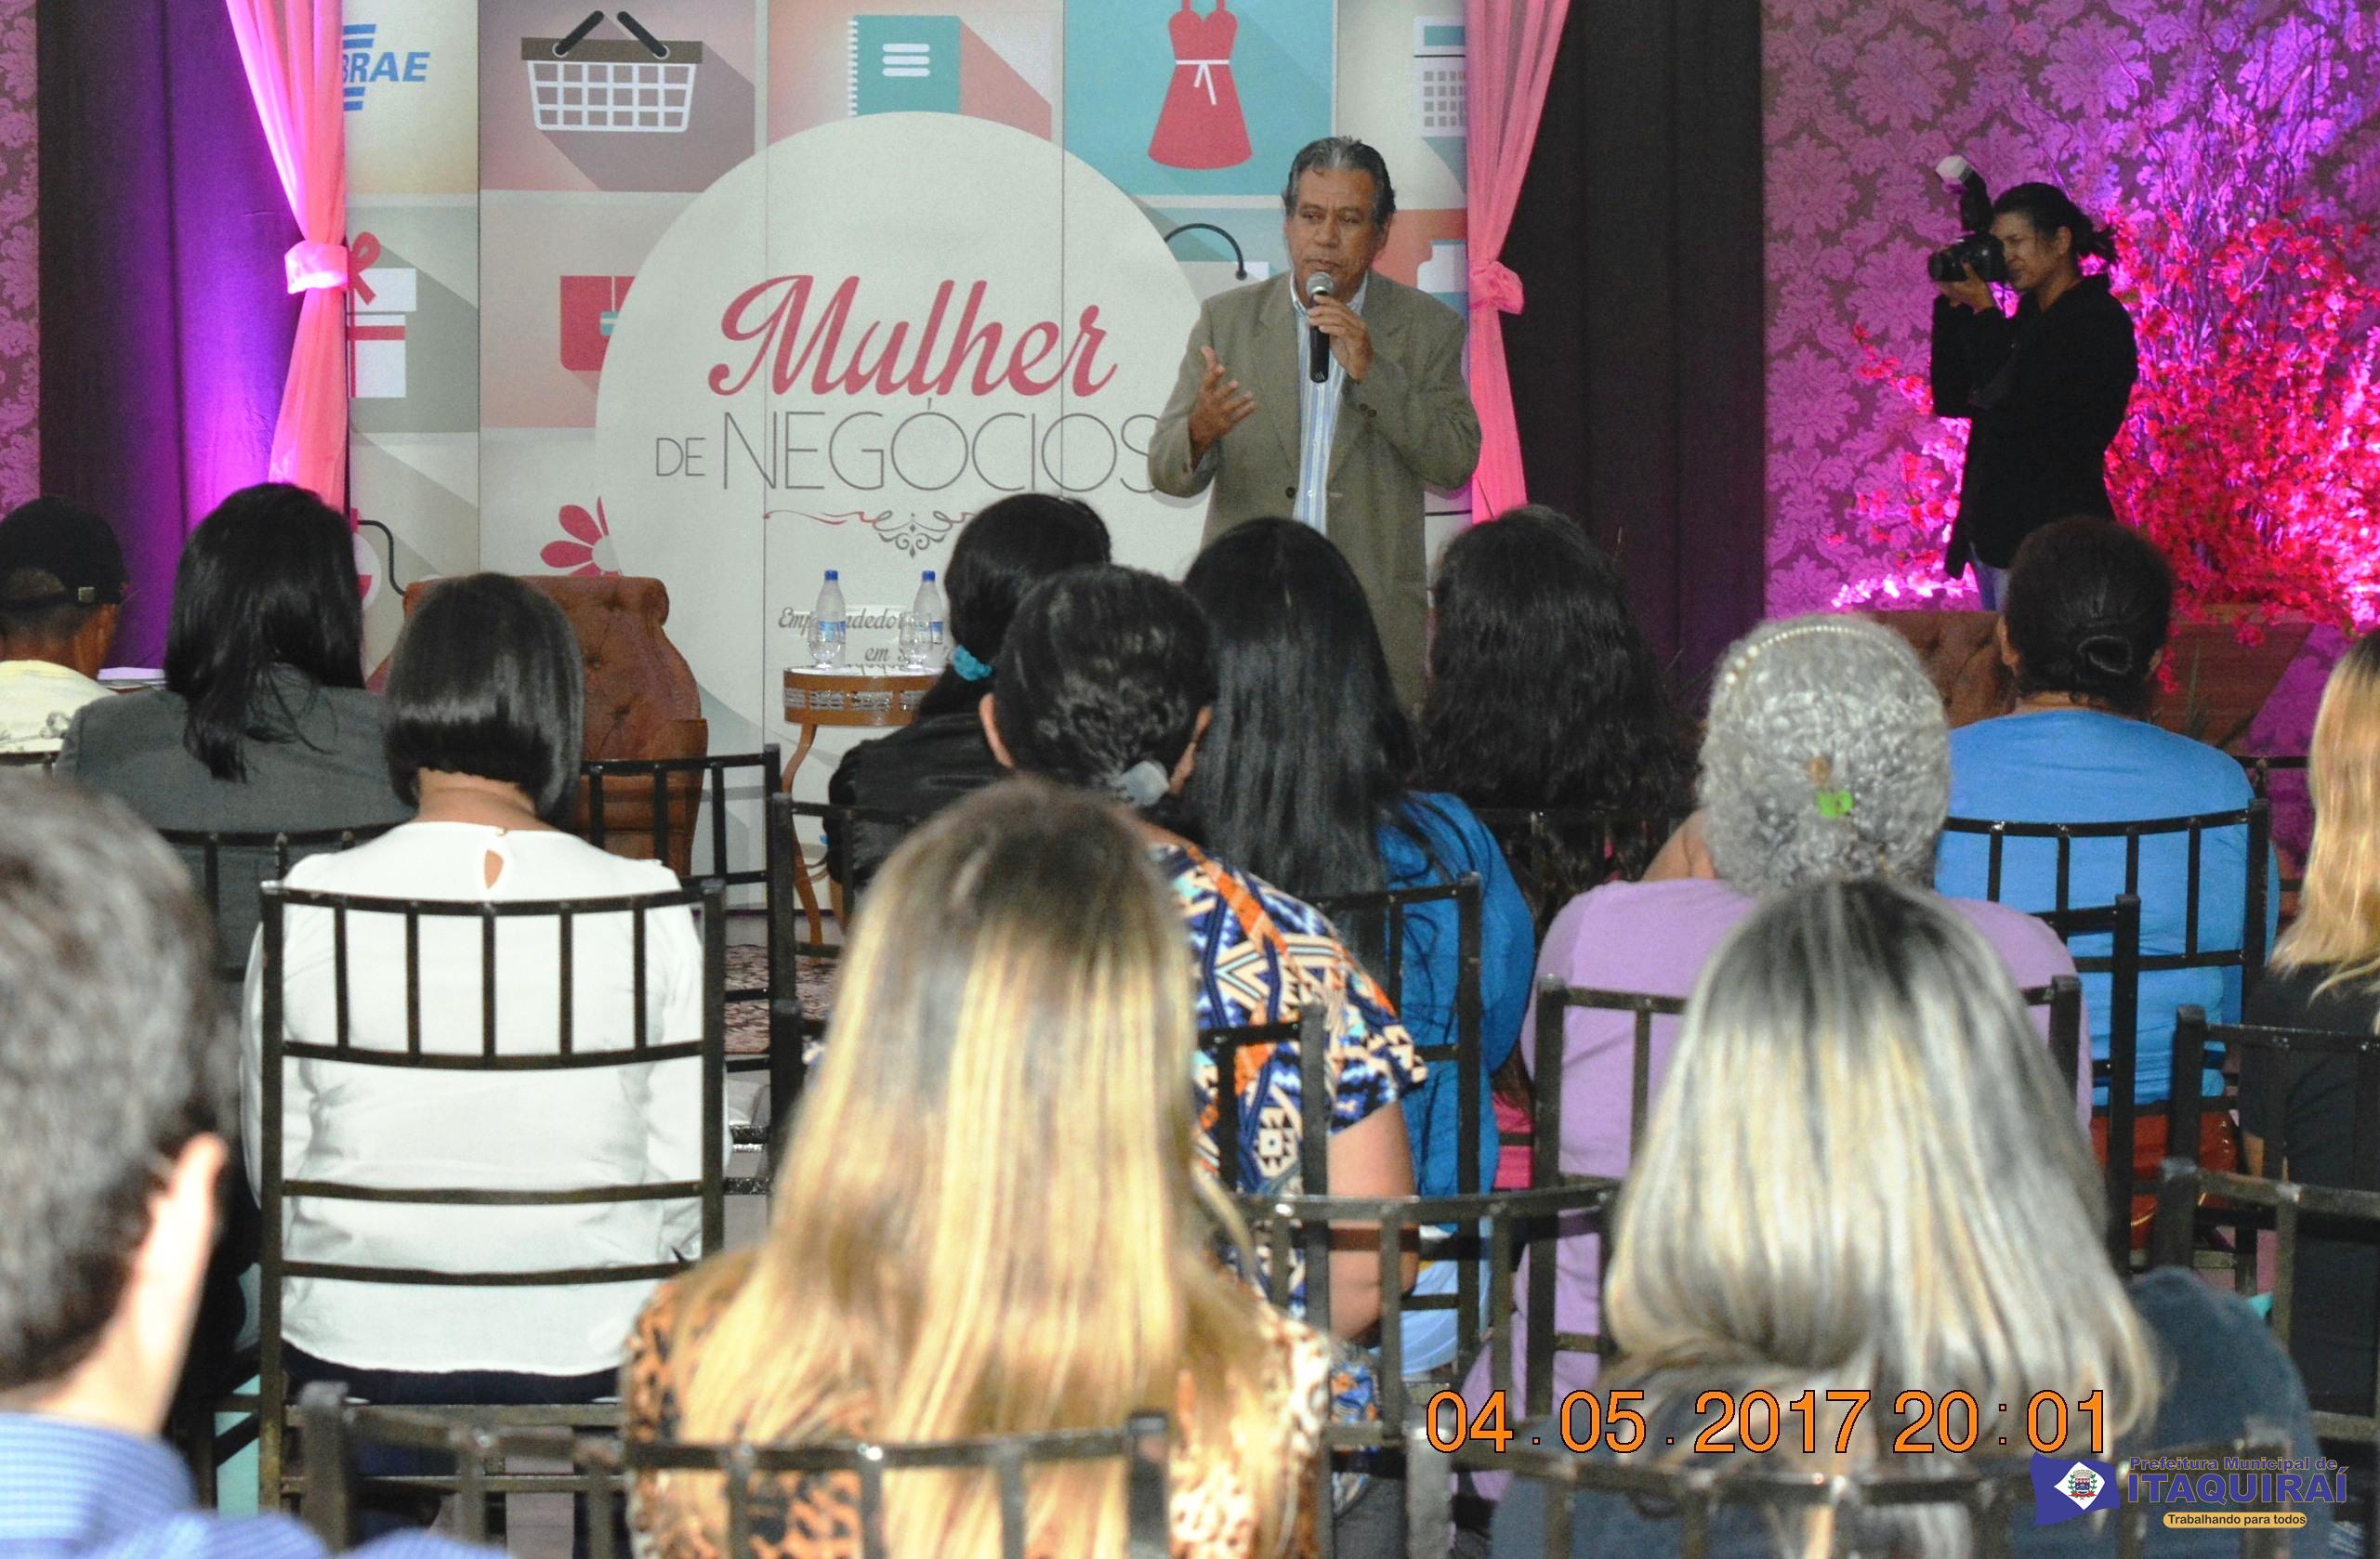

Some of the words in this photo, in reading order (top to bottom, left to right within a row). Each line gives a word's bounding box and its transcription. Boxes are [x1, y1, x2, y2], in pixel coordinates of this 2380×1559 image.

[707, 274, 1118, 398] Mulher
[655, 437, 706, 478] DE
[723, 397, 1159, 493] NEGÓCIOS
